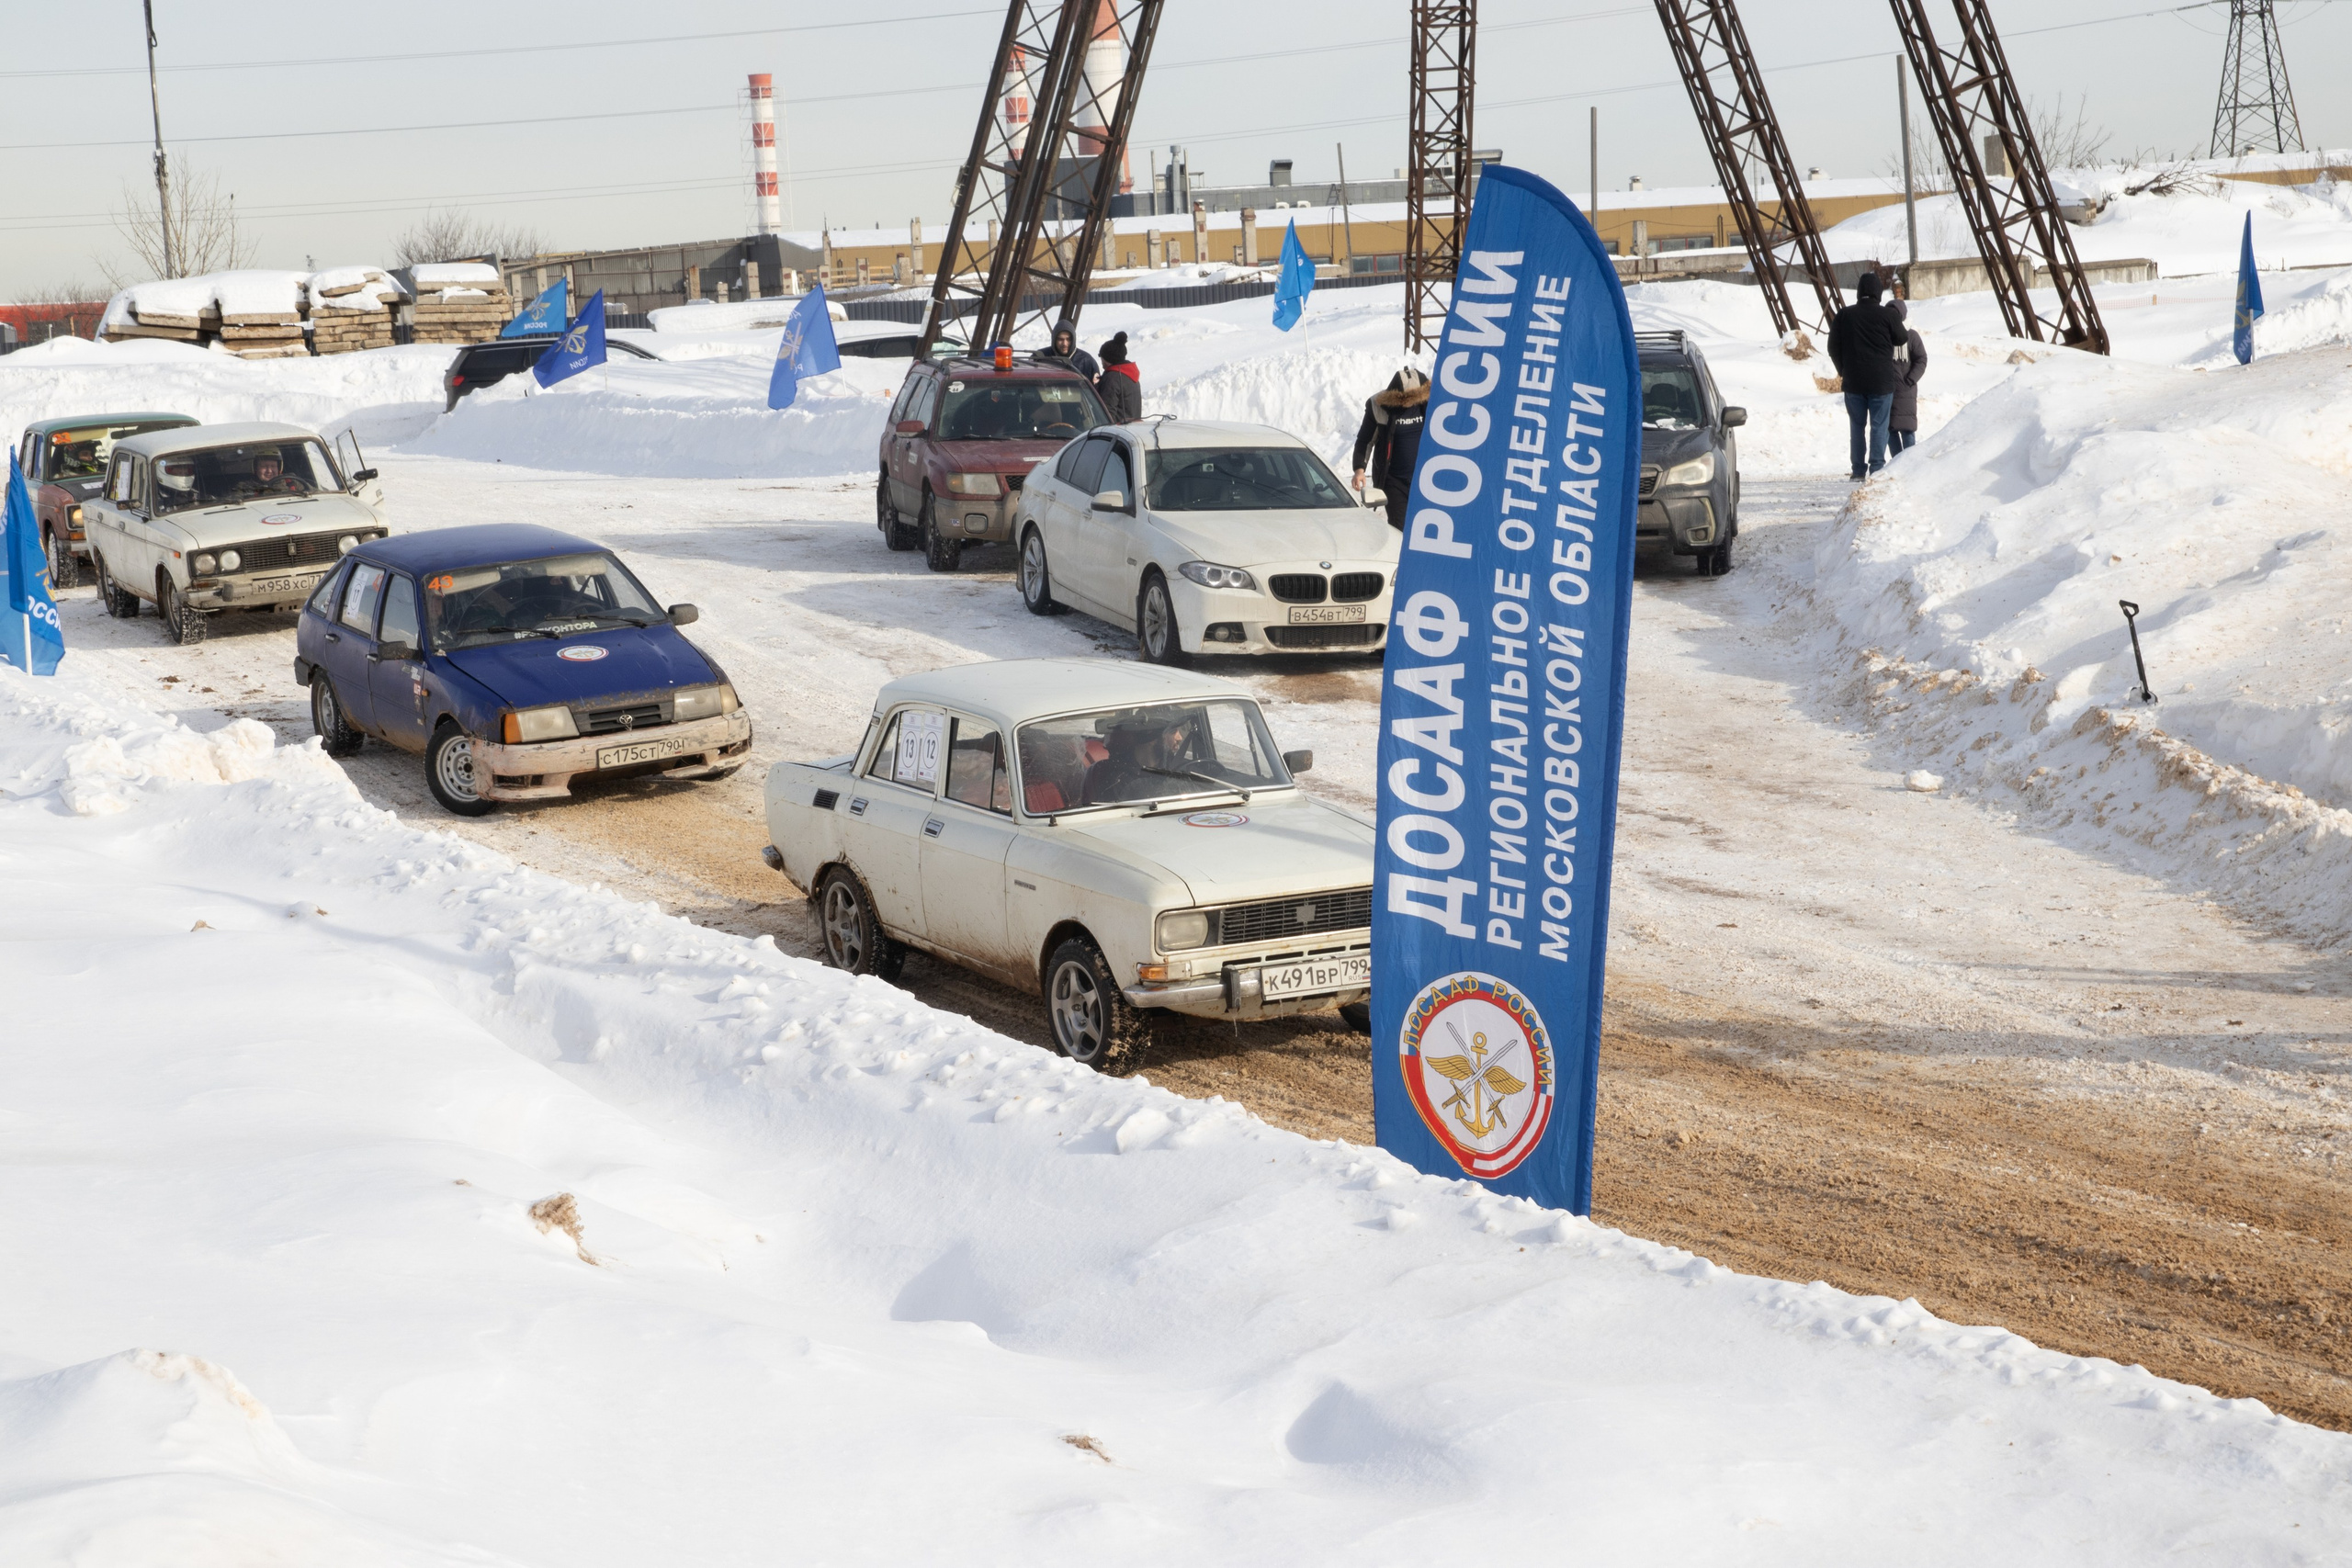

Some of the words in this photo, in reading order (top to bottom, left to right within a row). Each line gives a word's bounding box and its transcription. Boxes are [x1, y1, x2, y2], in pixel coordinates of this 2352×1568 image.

[1395, 415, 1424, 425] rhartt
[1408, 250, 1525, 559] РОССИИ
[1498, 275, 1572, 551] ОТДЕЛЕНИЕ
[1548, 381, 1606, 605] ОБЛАСТИ
[428, 575, 454, 591] 43
[1294, 608, 1342, 622] В454ВТ
[1344, 606, 1363, 617] 799
[603, 746, 656, 765] С175СТ
[659, 739, 680, 753] 790
[905, 738, 915, 760] 13
[926, 739, 936, 761] 12
[1386, 590, 1478, 940] ДОСААФ
[1486, 568, 1532, 950] РЕГИОНАЛЬНОЕ
[1538, 623, 1586, 964] МОСКОВСКОЙ
[1269, 965, 1339, 991] К491ВР
[1341, 958, 1368, 976] 799
[1348, 974, 1362, 982] RUS
[1402, 975, 1480, 1053] ДОСААФ
[1491, 980, 1554, 1086] РОССИИ
